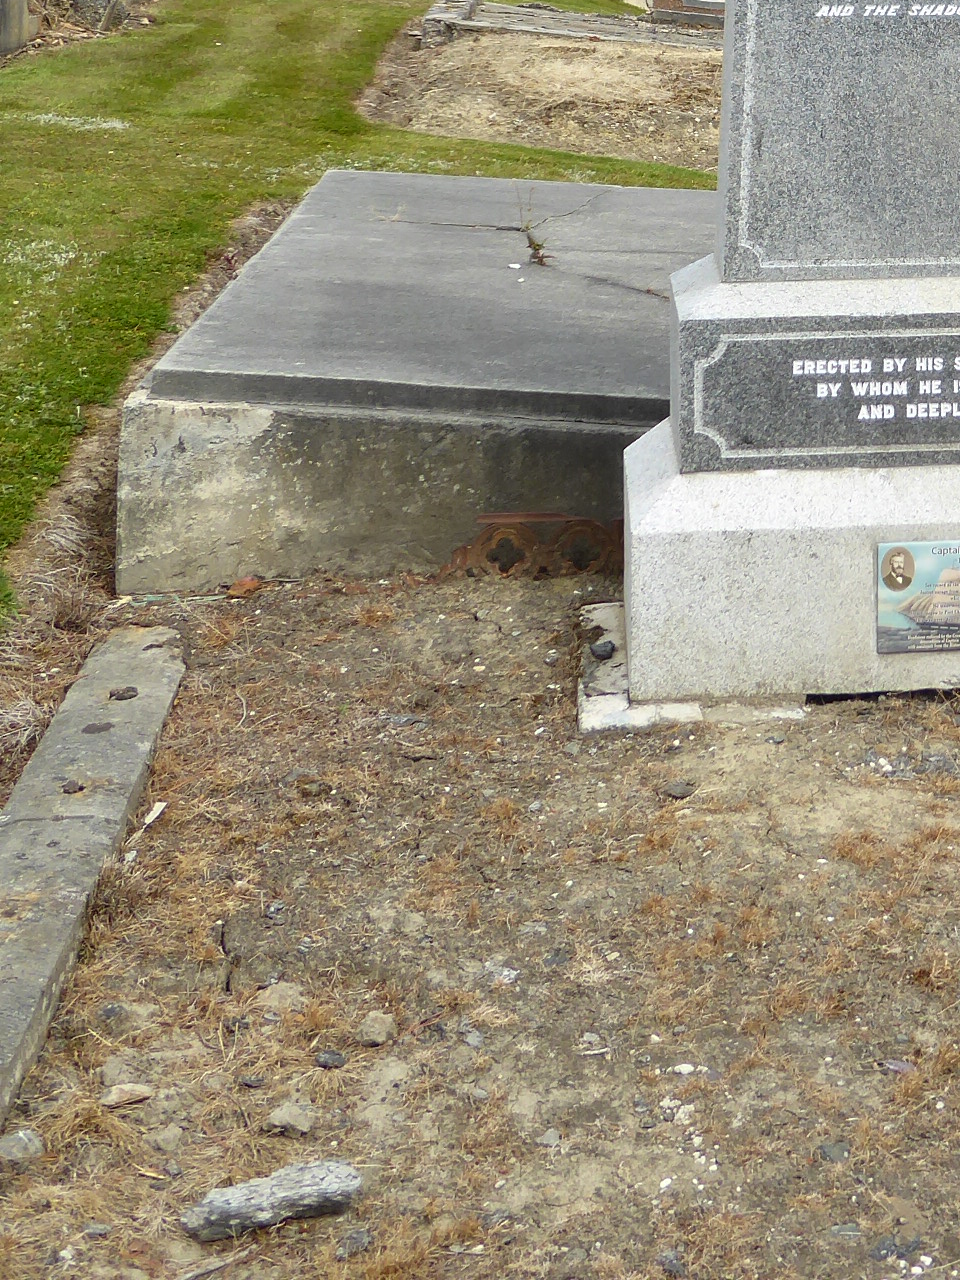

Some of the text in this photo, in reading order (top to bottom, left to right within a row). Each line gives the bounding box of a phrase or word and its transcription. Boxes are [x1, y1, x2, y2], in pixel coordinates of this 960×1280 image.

[816, 4, 854, 17] AND
[863, 4, 899, 17] THE
[792, 360, 872, 375] ERECTED
[883, 358, 907, 372] BY
[916, 358, 943, 371] HIS
[817, 383, 842, 398] BY
[851, 381, 907, 396] WHOM
[919, 380, 941, 394] HE
[858, 405, 894, 420] AND
